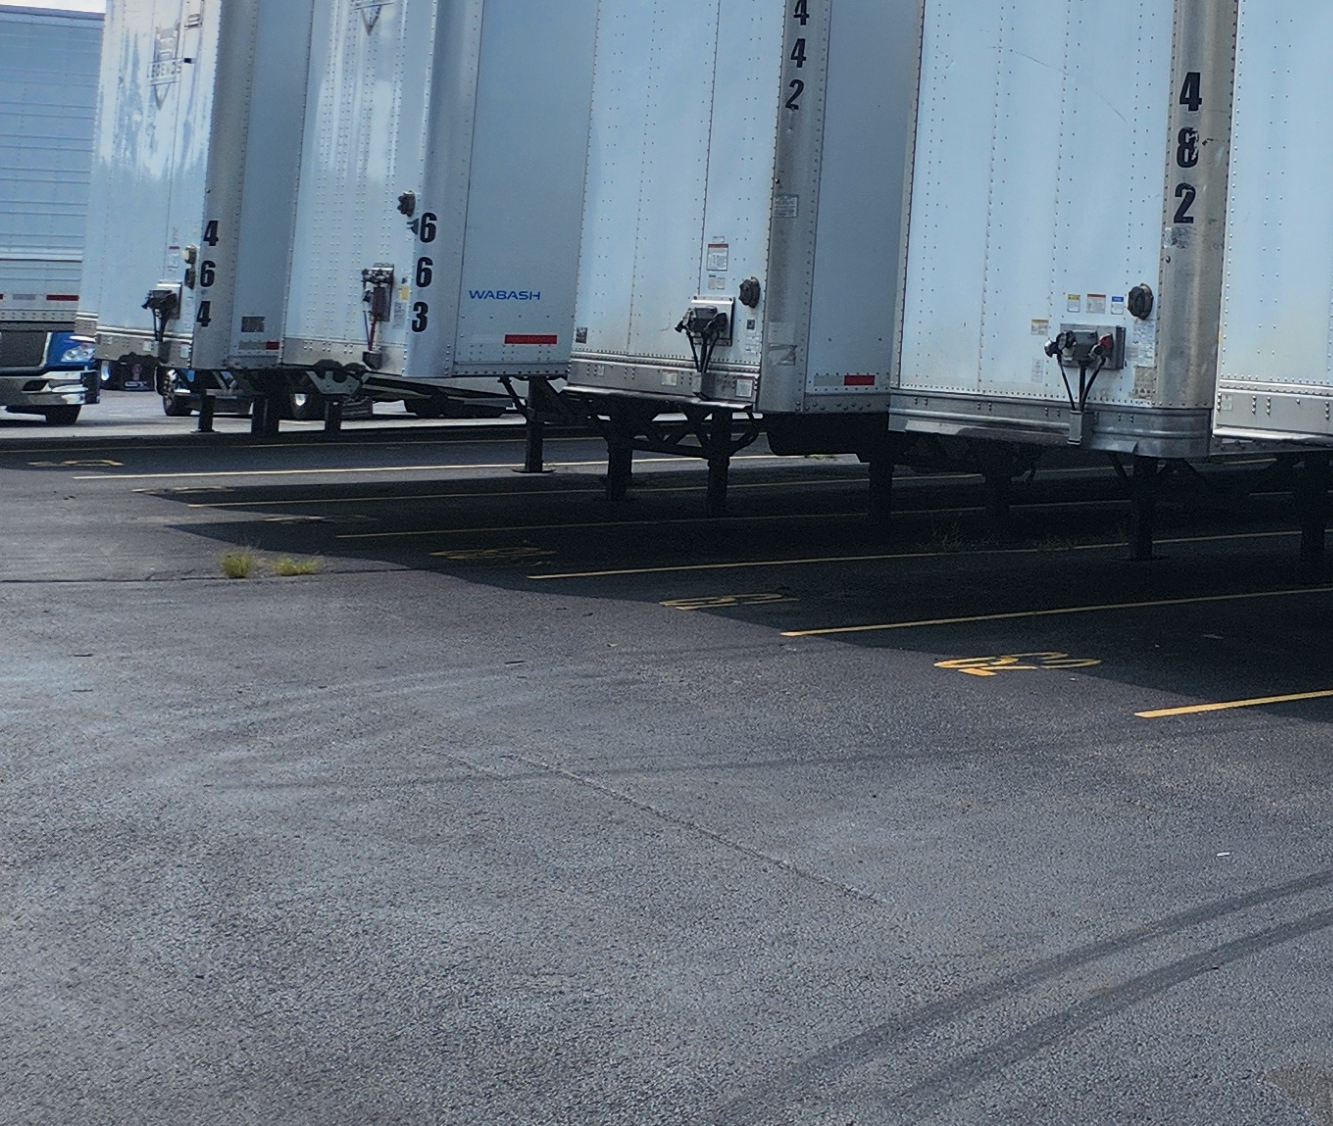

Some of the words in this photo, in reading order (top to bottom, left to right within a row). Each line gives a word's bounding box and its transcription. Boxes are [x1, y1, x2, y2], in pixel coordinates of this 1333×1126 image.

[1173, 72, 1202, 224] 482
[196, 220, 219, 327] 464
[411, 212, 438, 332] 663
[469, 290, 541, 301] WABASH
